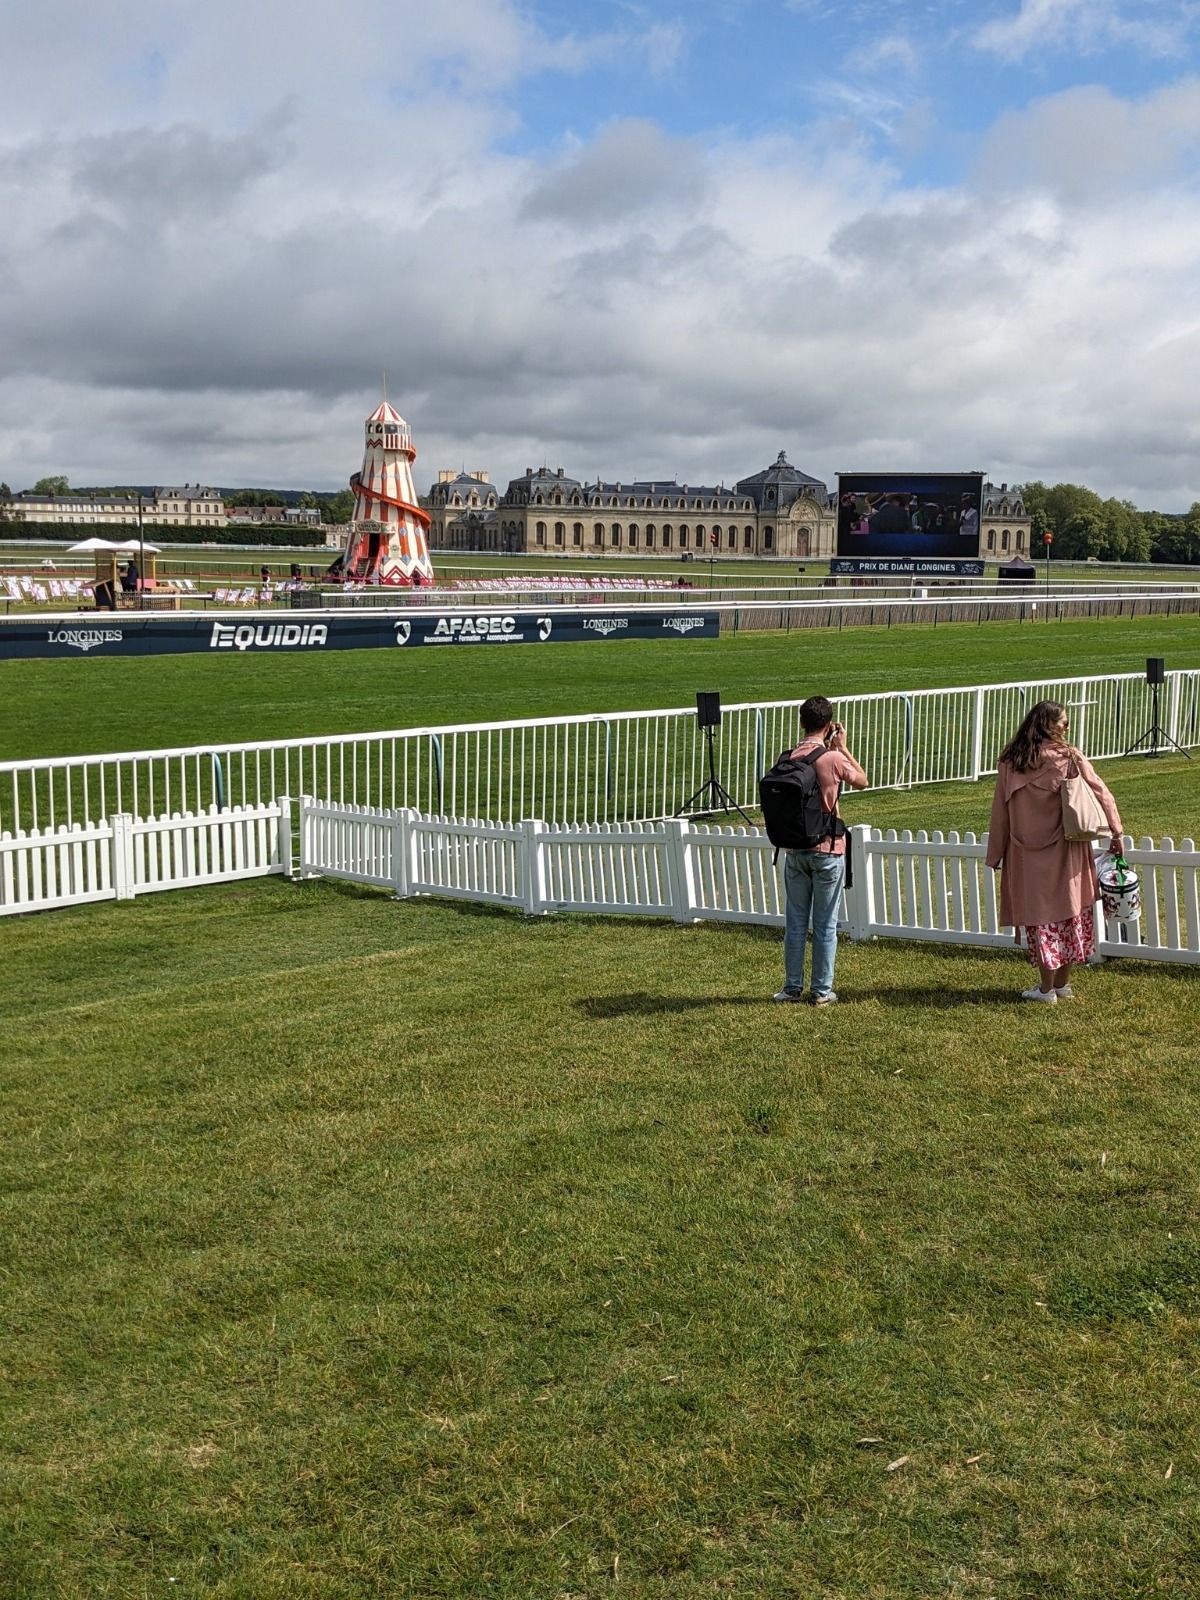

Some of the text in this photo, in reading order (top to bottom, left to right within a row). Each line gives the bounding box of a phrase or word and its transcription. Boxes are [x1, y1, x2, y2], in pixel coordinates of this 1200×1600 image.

[859, 562, 877, 571] PRIX
[878, 562, 890, 571] DE
[891, 562, 915, 571] DIANE
[916, 563, 956, 572] LONGINES
[434, 617, 516, 634] AFASEC
[583, 618, 629, 629] LONGINES
[662, 617, 705, 628] LONGINES
[47, 630, 123, 643] LONGINES
[210, 622, 328, 651] EQUIDIA
